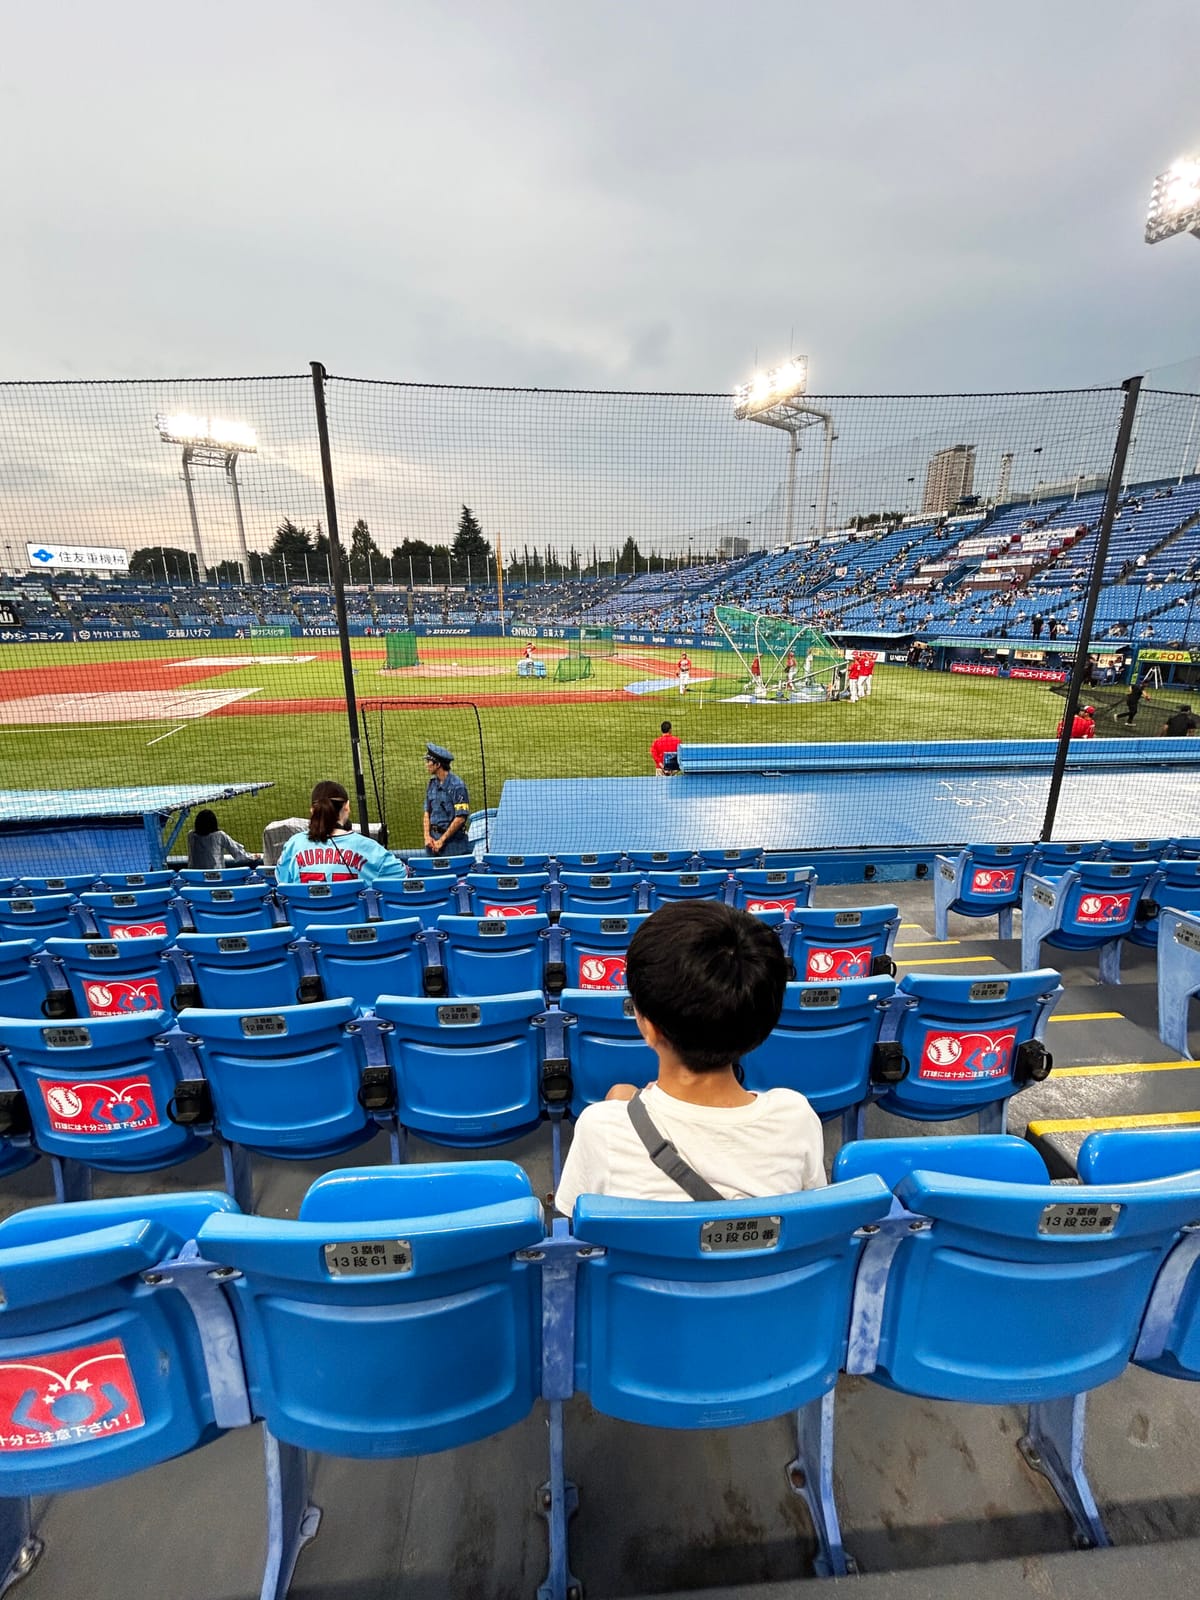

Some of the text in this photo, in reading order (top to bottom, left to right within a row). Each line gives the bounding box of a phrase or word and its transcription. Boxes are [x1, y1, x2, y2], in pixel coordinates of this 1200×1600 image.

[59, 551, 126, 566] 住友重機械
[92, 630, 141, 639] 竹中工務店
[302, 628, 331, 636] KYOEI
[296, 848, 368, 871] MURAKAMI
[332, 1253, 406, 1267] 13段61番
